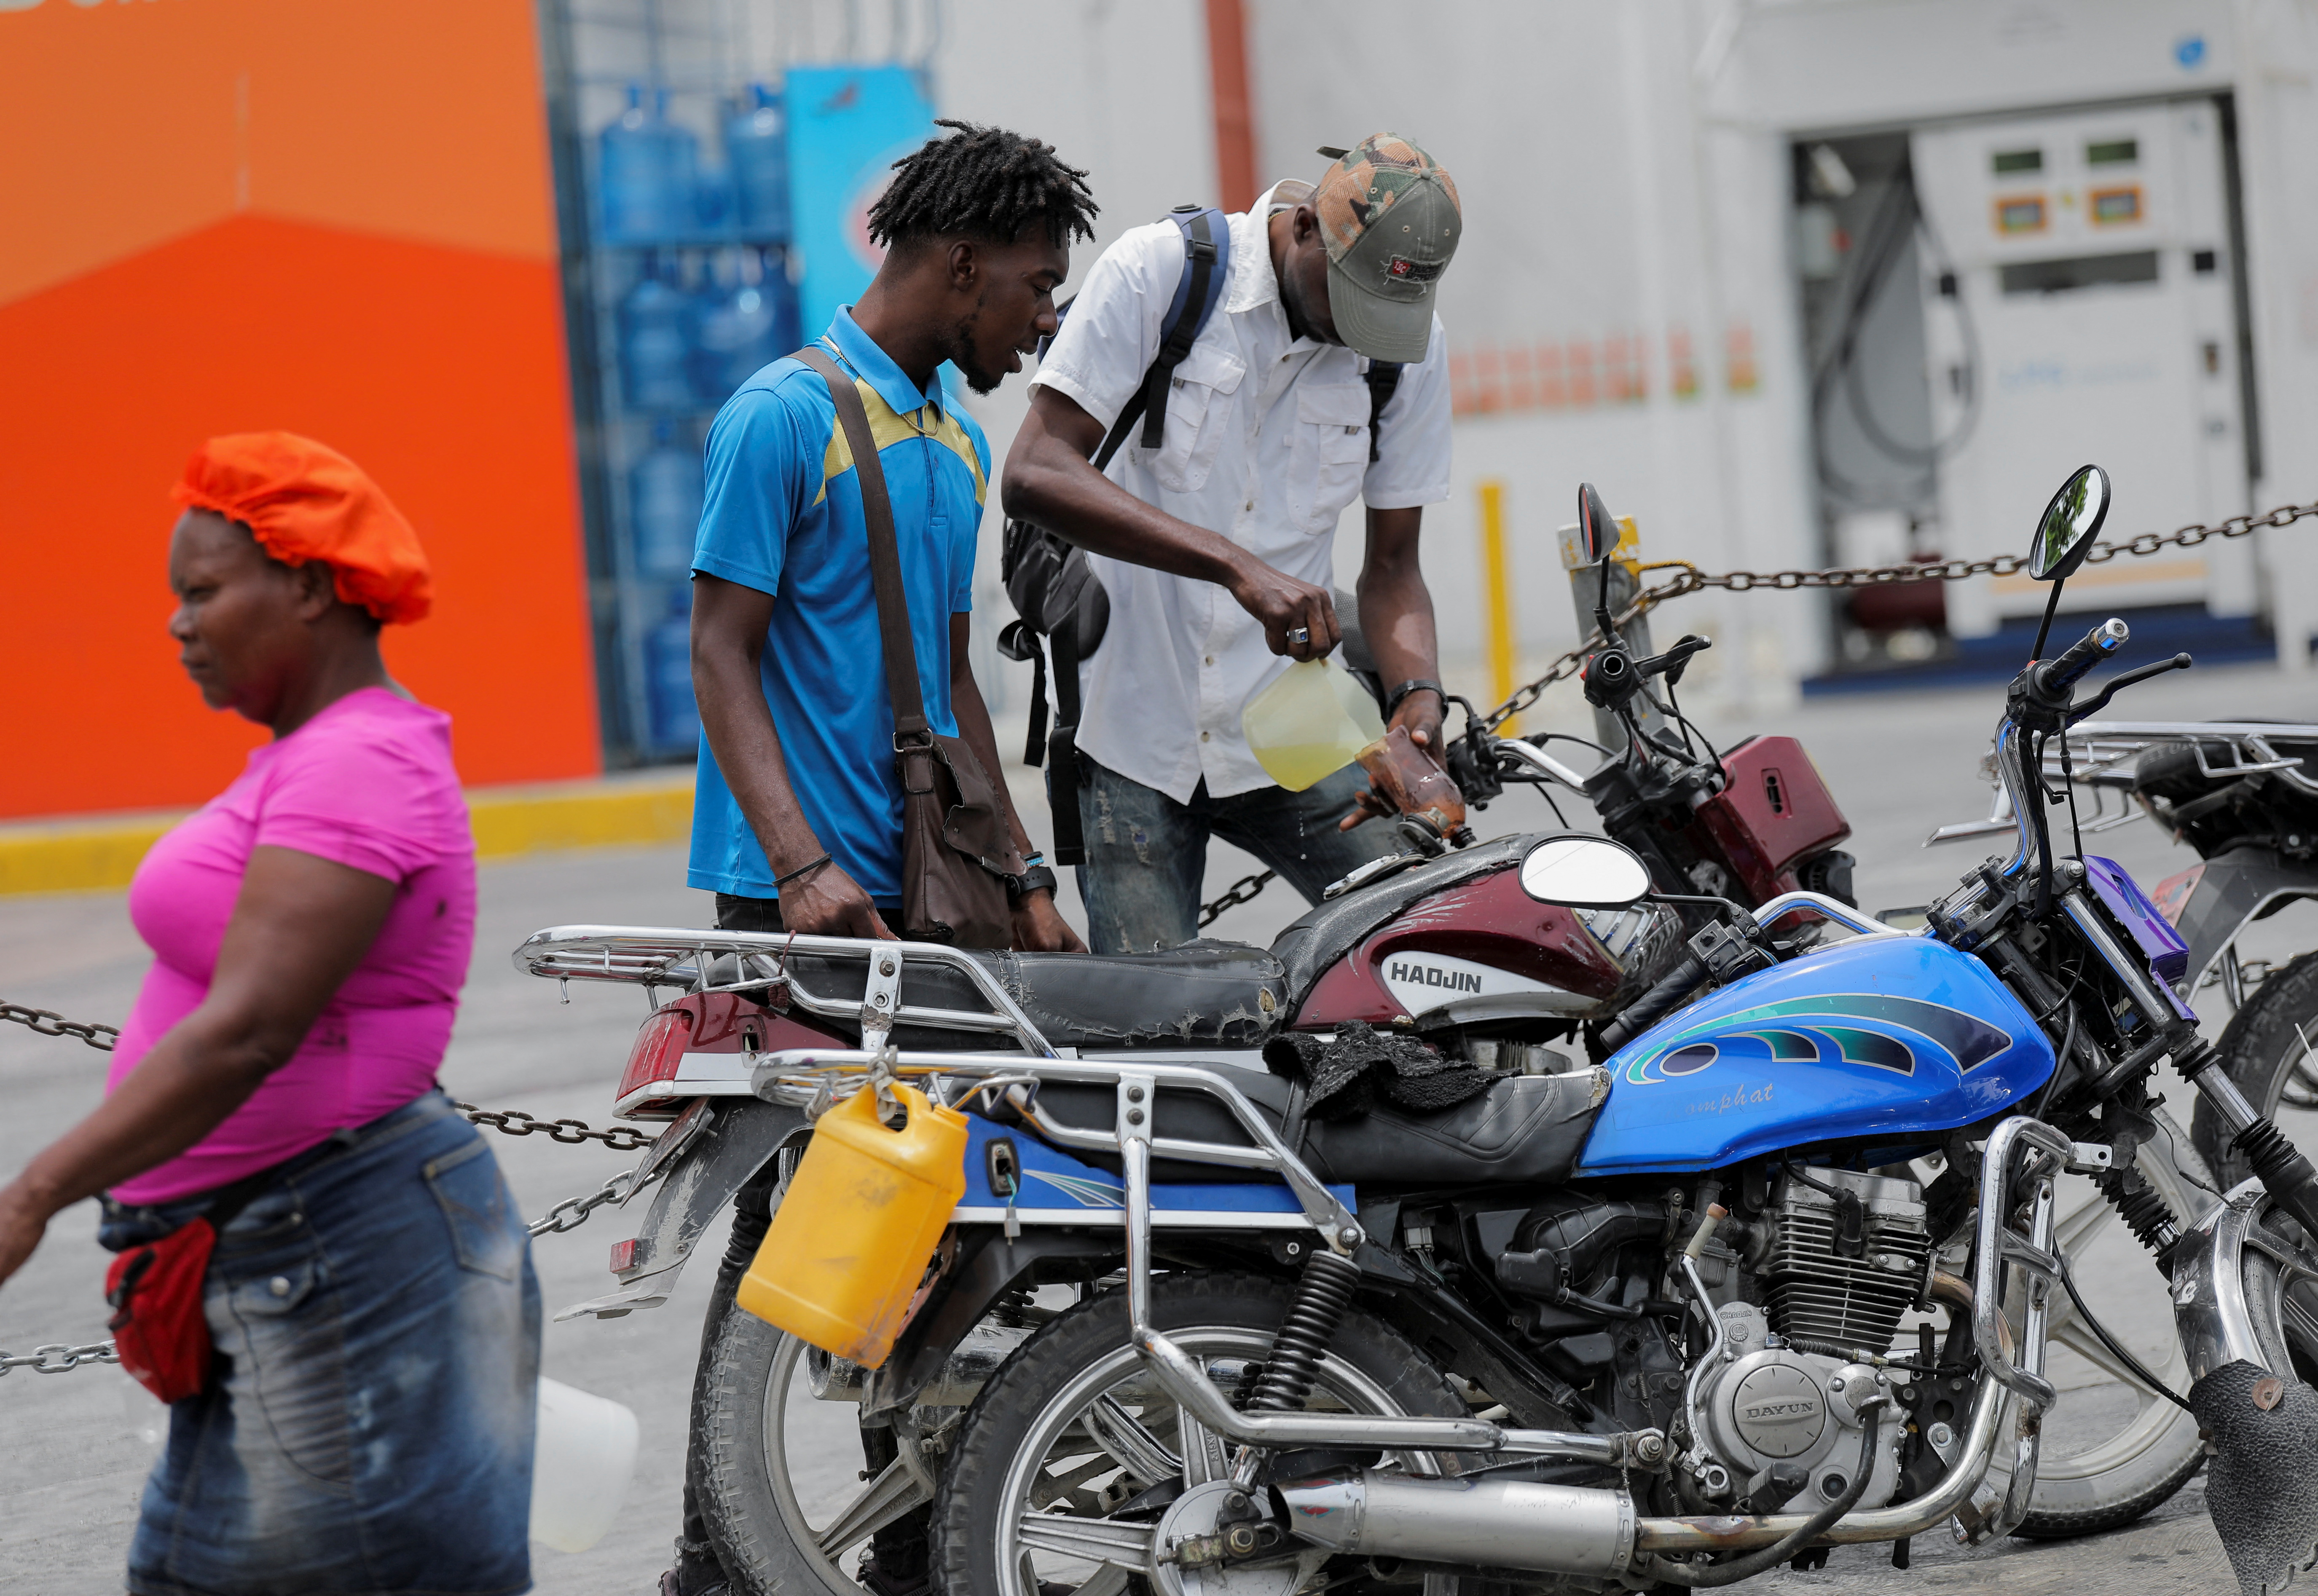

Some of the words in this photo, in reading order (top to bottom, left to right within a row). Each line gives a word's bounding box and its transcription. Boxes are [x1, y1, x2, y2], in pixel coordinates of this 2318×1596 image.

[1392, 962, 1481, 993] HAOJIN
[1727, 1310, 1752, 1318] HAOJIN
[1746, 1402, 1814, 1419] DAYUN
